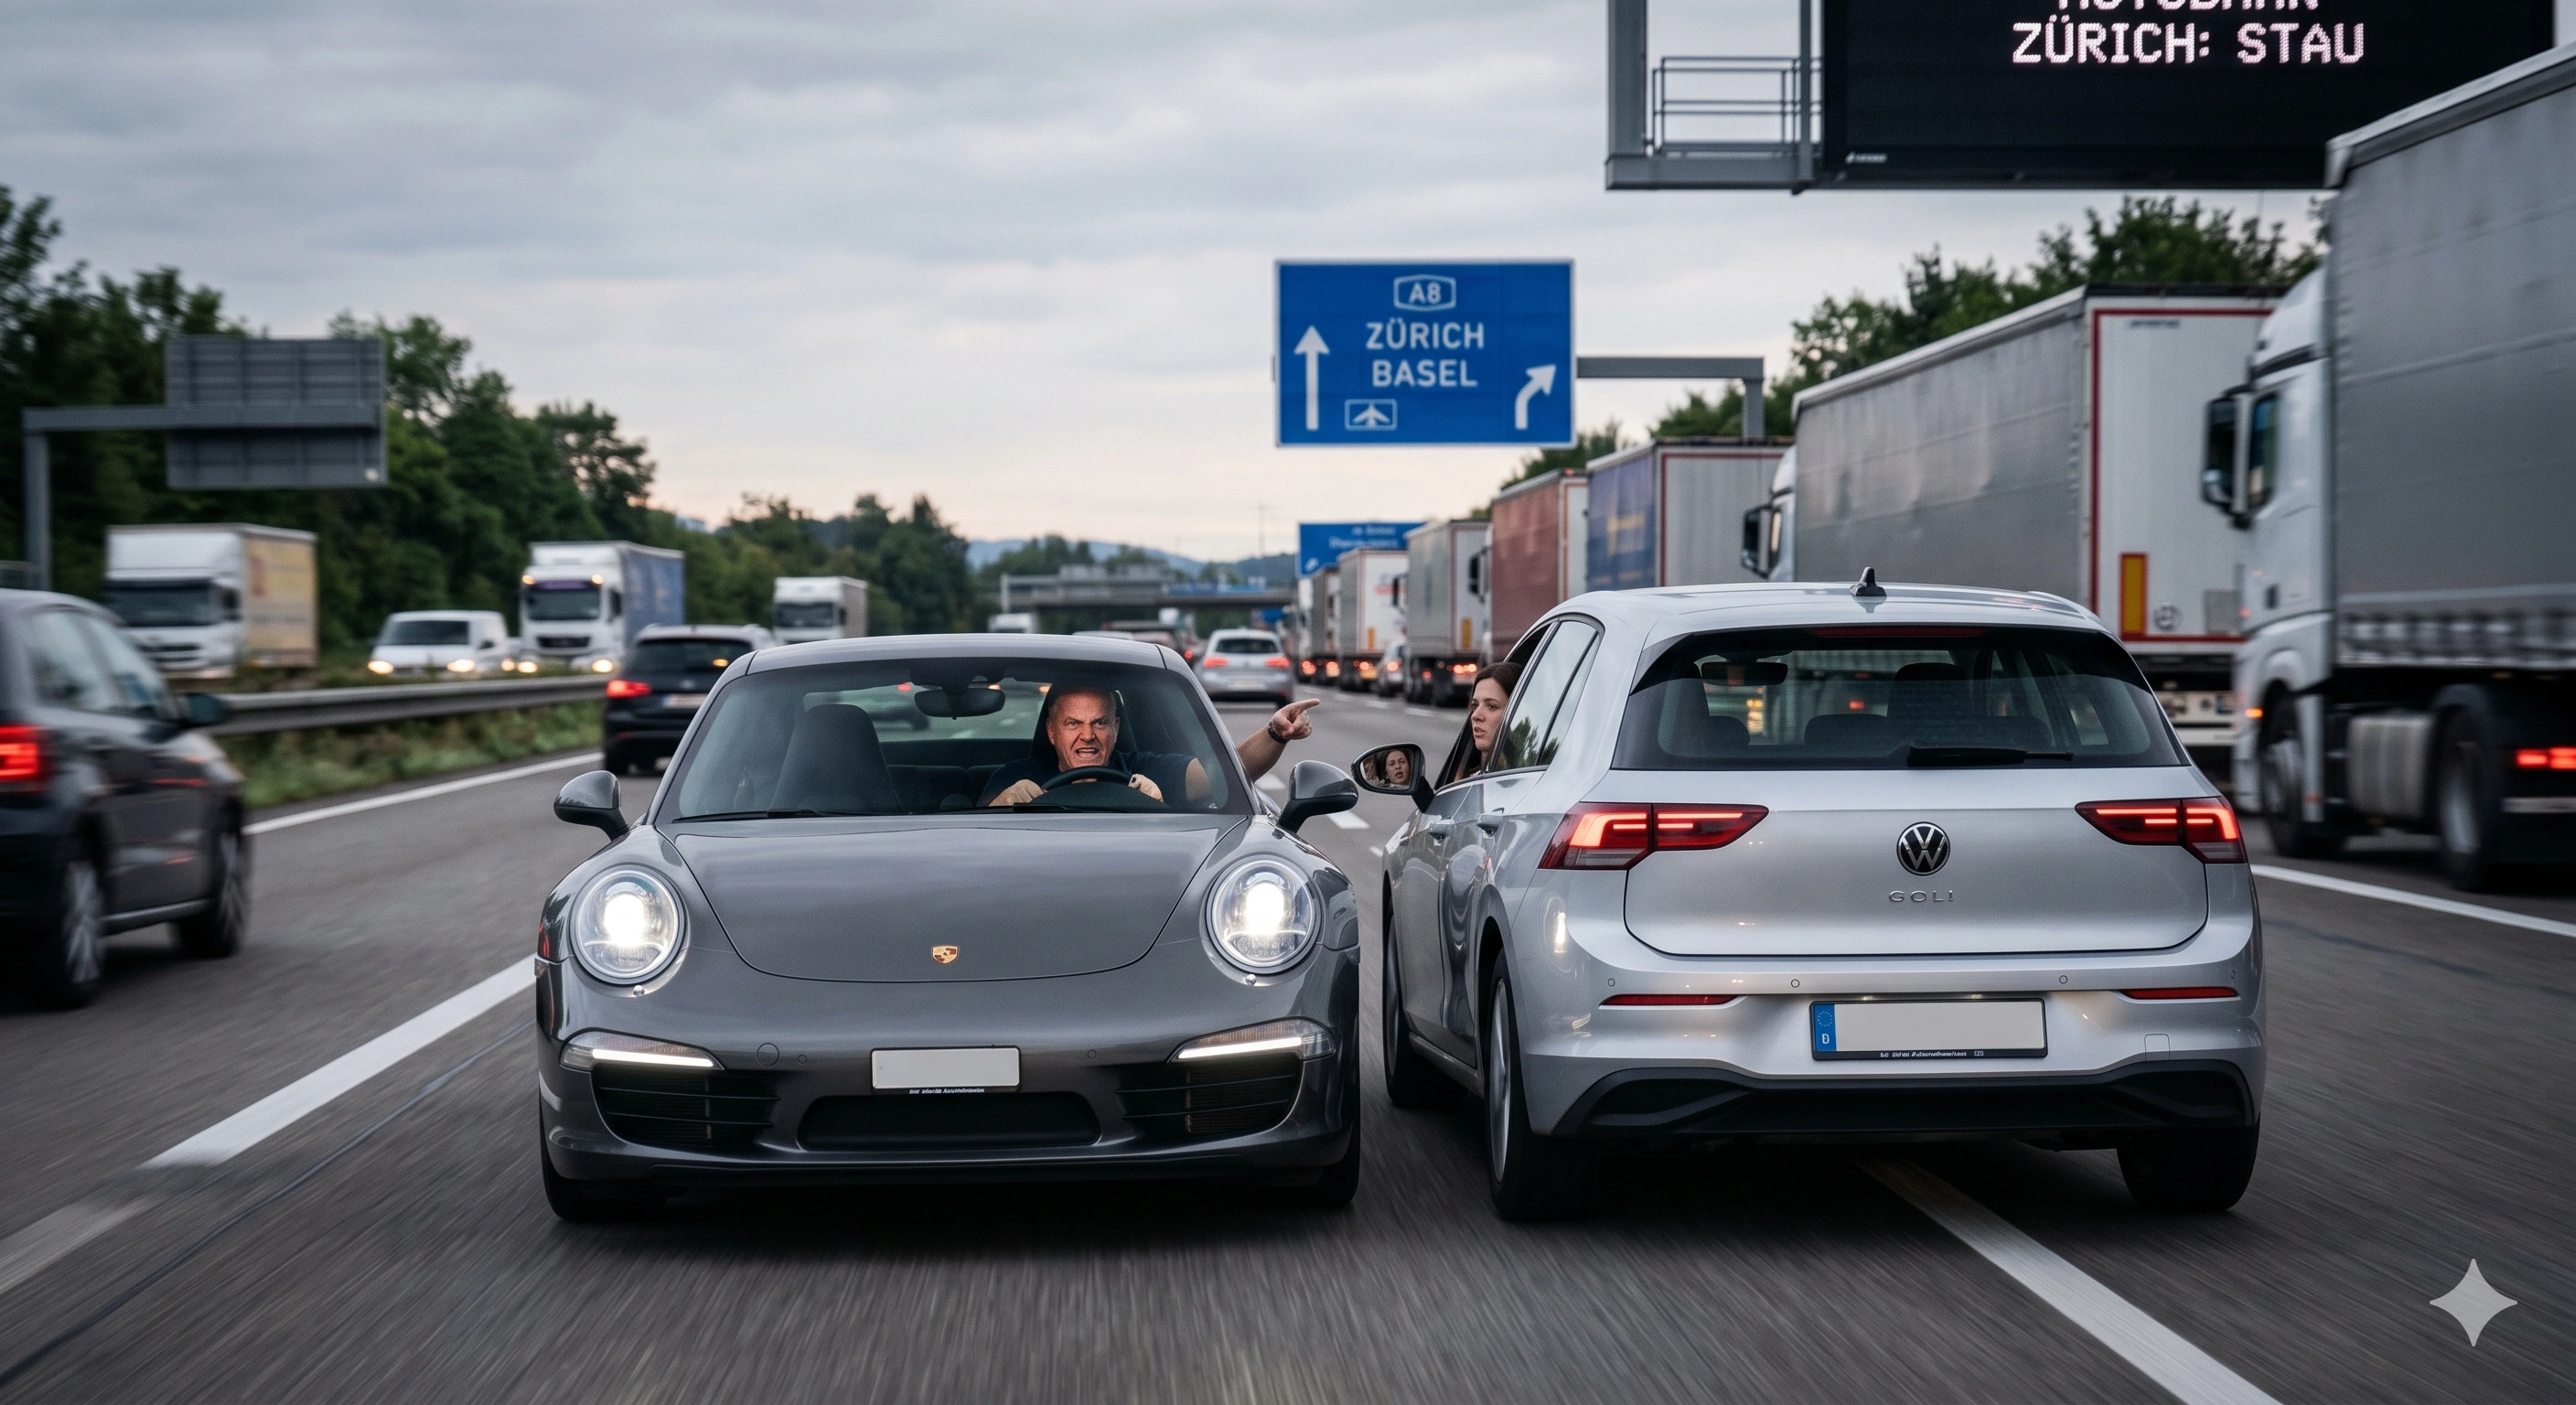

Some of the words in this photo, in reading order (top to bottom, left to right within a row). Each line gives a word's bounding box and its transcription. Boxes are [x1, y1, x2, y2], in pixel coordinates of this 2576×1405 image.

[2012, 14, 2210, 64] ZÜRICH:
[2237, 22, 2365, 64] STAU
[1408, 282, 1442, 305] A8
[1365, 316, 1486, 350] ZÜRICH
[1371, 359, 1478, 389] BASEL
[1821, 1033, 1830, 1045] D
